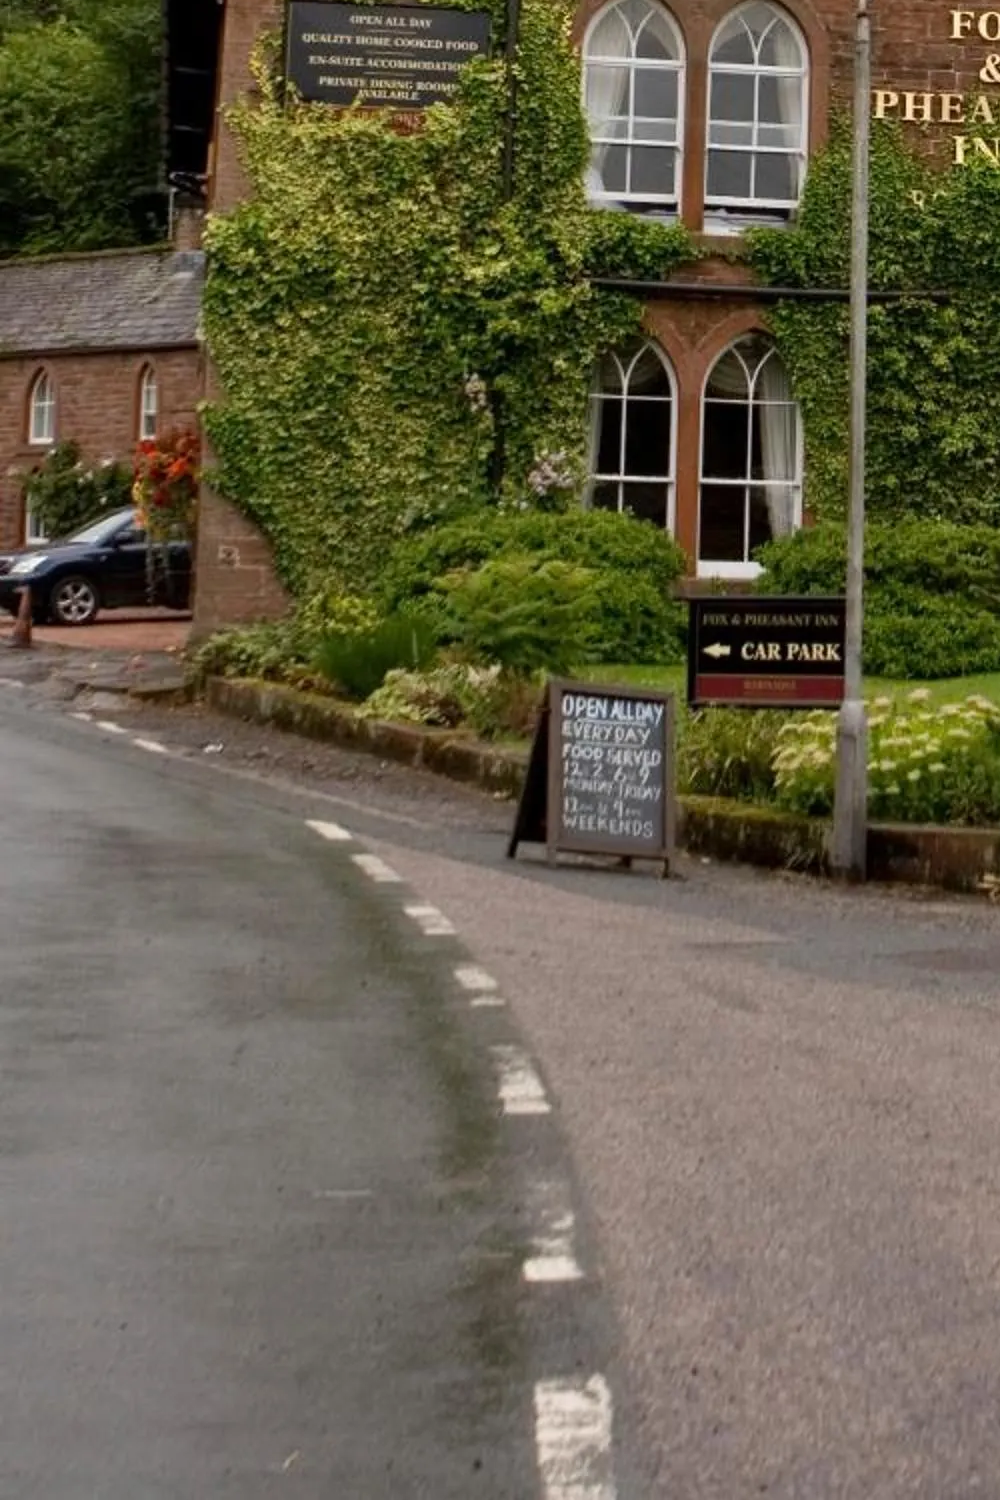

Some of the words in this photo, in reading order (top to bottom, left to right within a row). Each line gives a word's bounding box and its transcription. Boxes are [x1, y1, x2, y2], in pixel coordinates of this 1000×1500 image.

[349, 14, 384, 25] OPEN
[385, 16, 407, 27] ALL
[409, 18, 433, 28] DAY
[302, 33, 353, 45] QUALITY
[356, 35, 393, 46] HOME
[394, 37, 443, 49] COOKED
[445, 41, 479, 51] FOOD
[319, 76, 366, 87] PRIVATE
[358, 90, 420, 101] AVAILABLE
[702, 613, 729, 626] FOX
[744, 613, 812, 627] PHEASANT
[815, 614, 840, 626] INN
[740, 641, 782, 661] CAR
[786, 643, 842, 661] PARK
[562, 694, 608, 719] OPEN
[609, 700, 635, 721] ALL
[635, 702, 664, 726] DAY
[562, 743, 604, 761] FOOD
[562, 812, 654, 838] WEEKENDS
